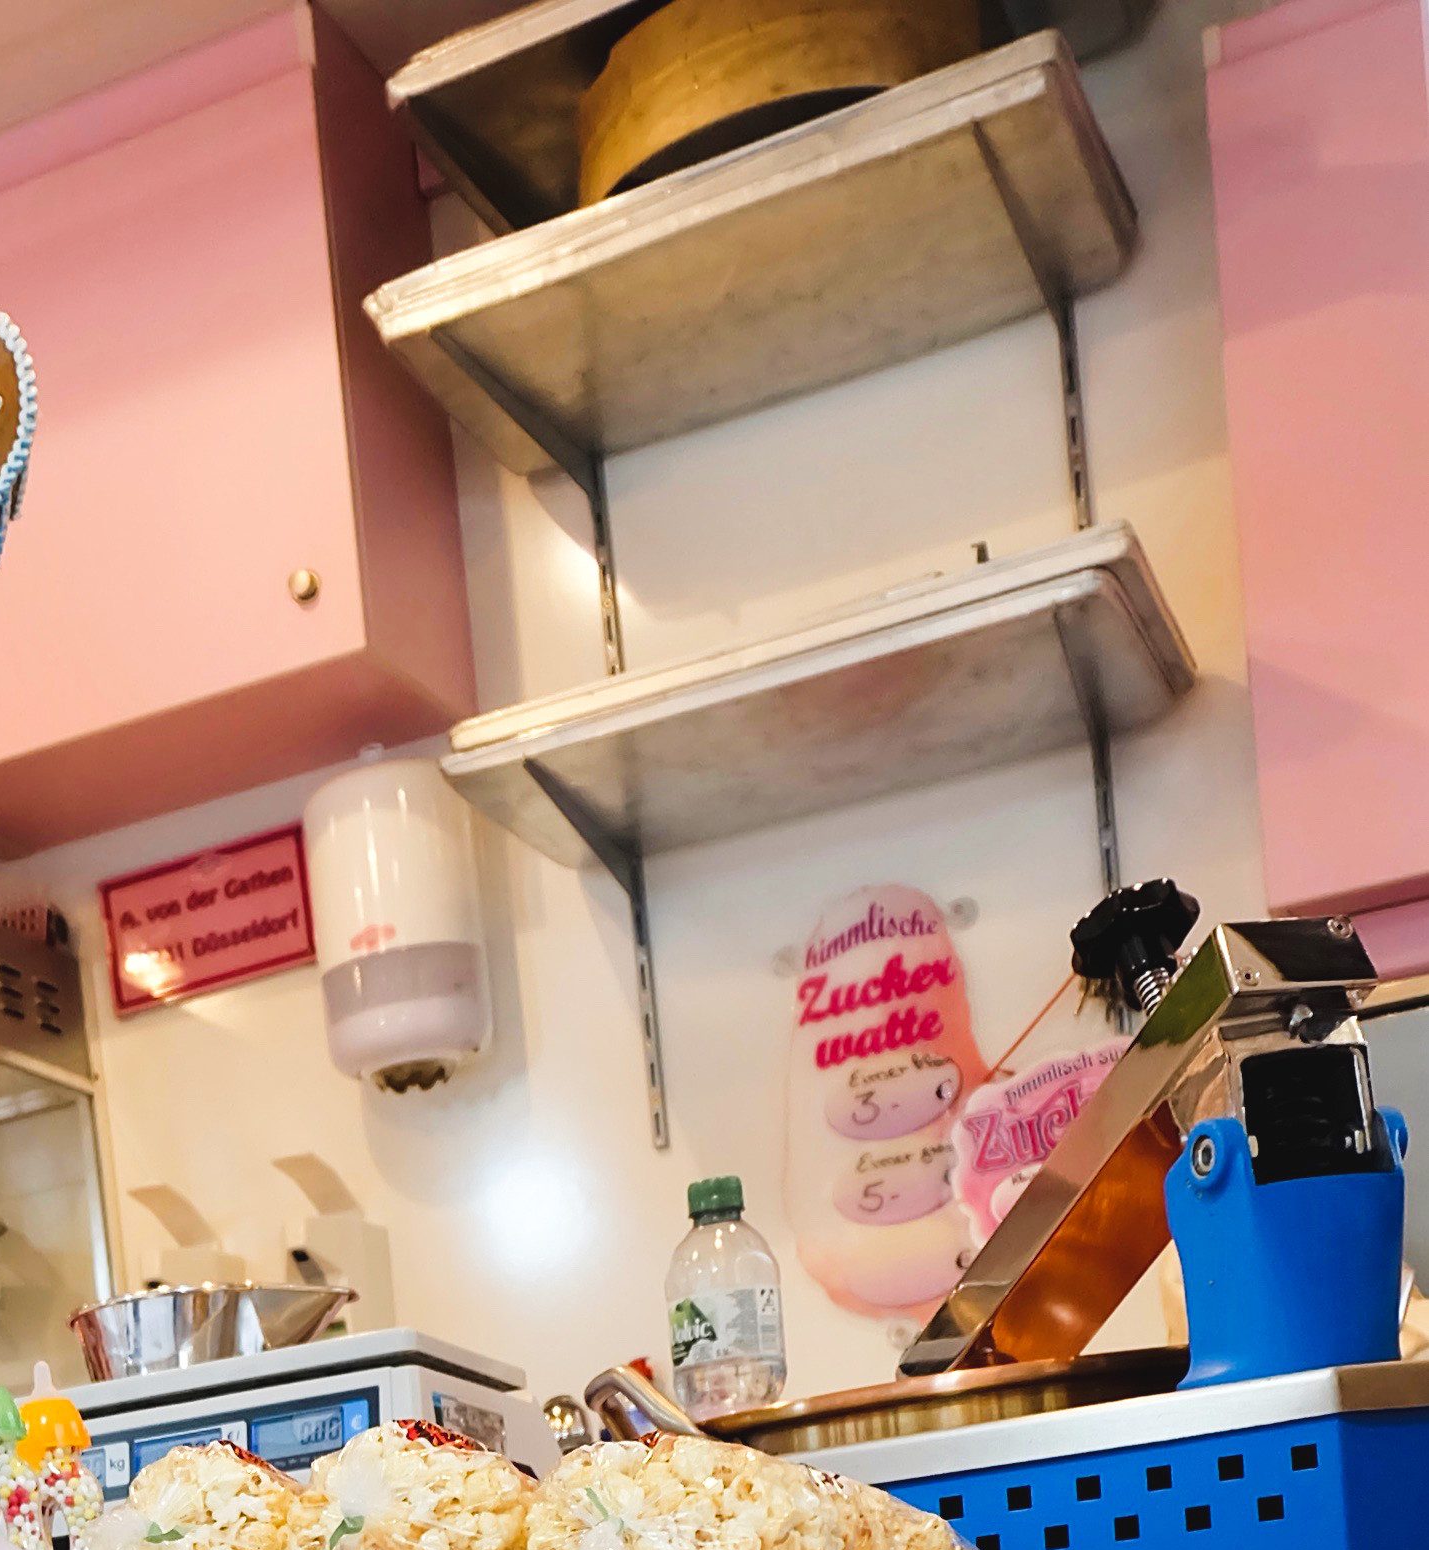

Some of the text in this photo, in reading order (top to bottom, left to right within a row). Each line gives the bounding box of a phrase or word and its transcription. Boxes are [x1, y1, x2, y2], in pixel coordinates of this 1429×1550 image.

[805, 902, 938, 970] himmlische
[798, 953, 955, 1027] Zucker
[815, 1006, 944, 1070] watte
[109, 1458, 125, 1471] kg
